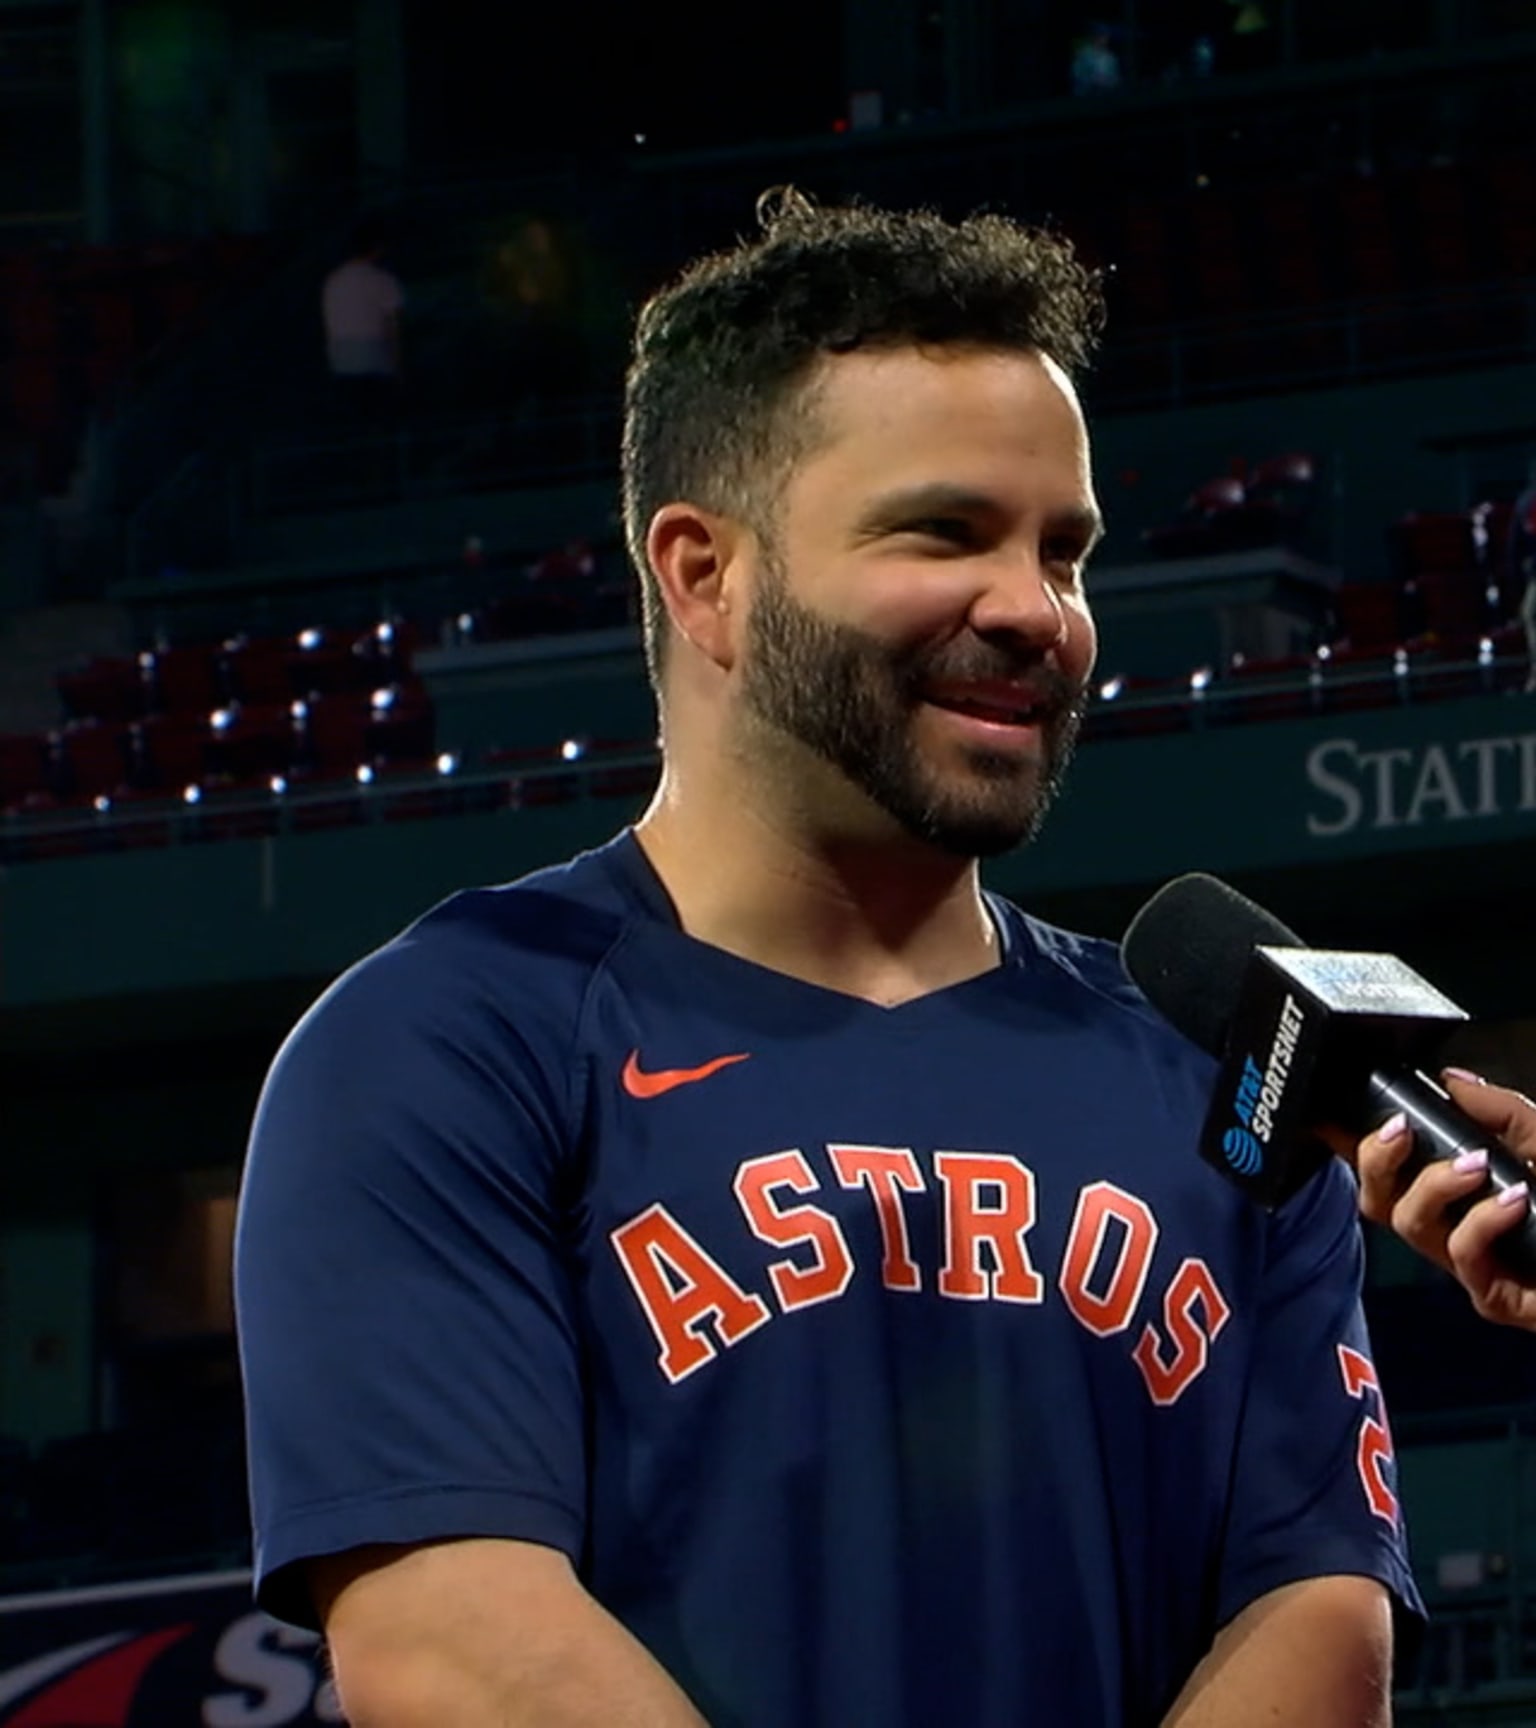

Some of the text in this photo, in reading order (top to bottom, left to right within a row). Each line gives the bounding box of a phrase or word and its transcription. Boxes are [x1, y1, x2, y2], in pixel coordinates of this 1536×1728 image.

[1233, 1052, 1264, 1125] AT&T
[1252, 993, 1305, 1144] SPORTSNET
[610, 1143, 1231, 1406] ASTROS
